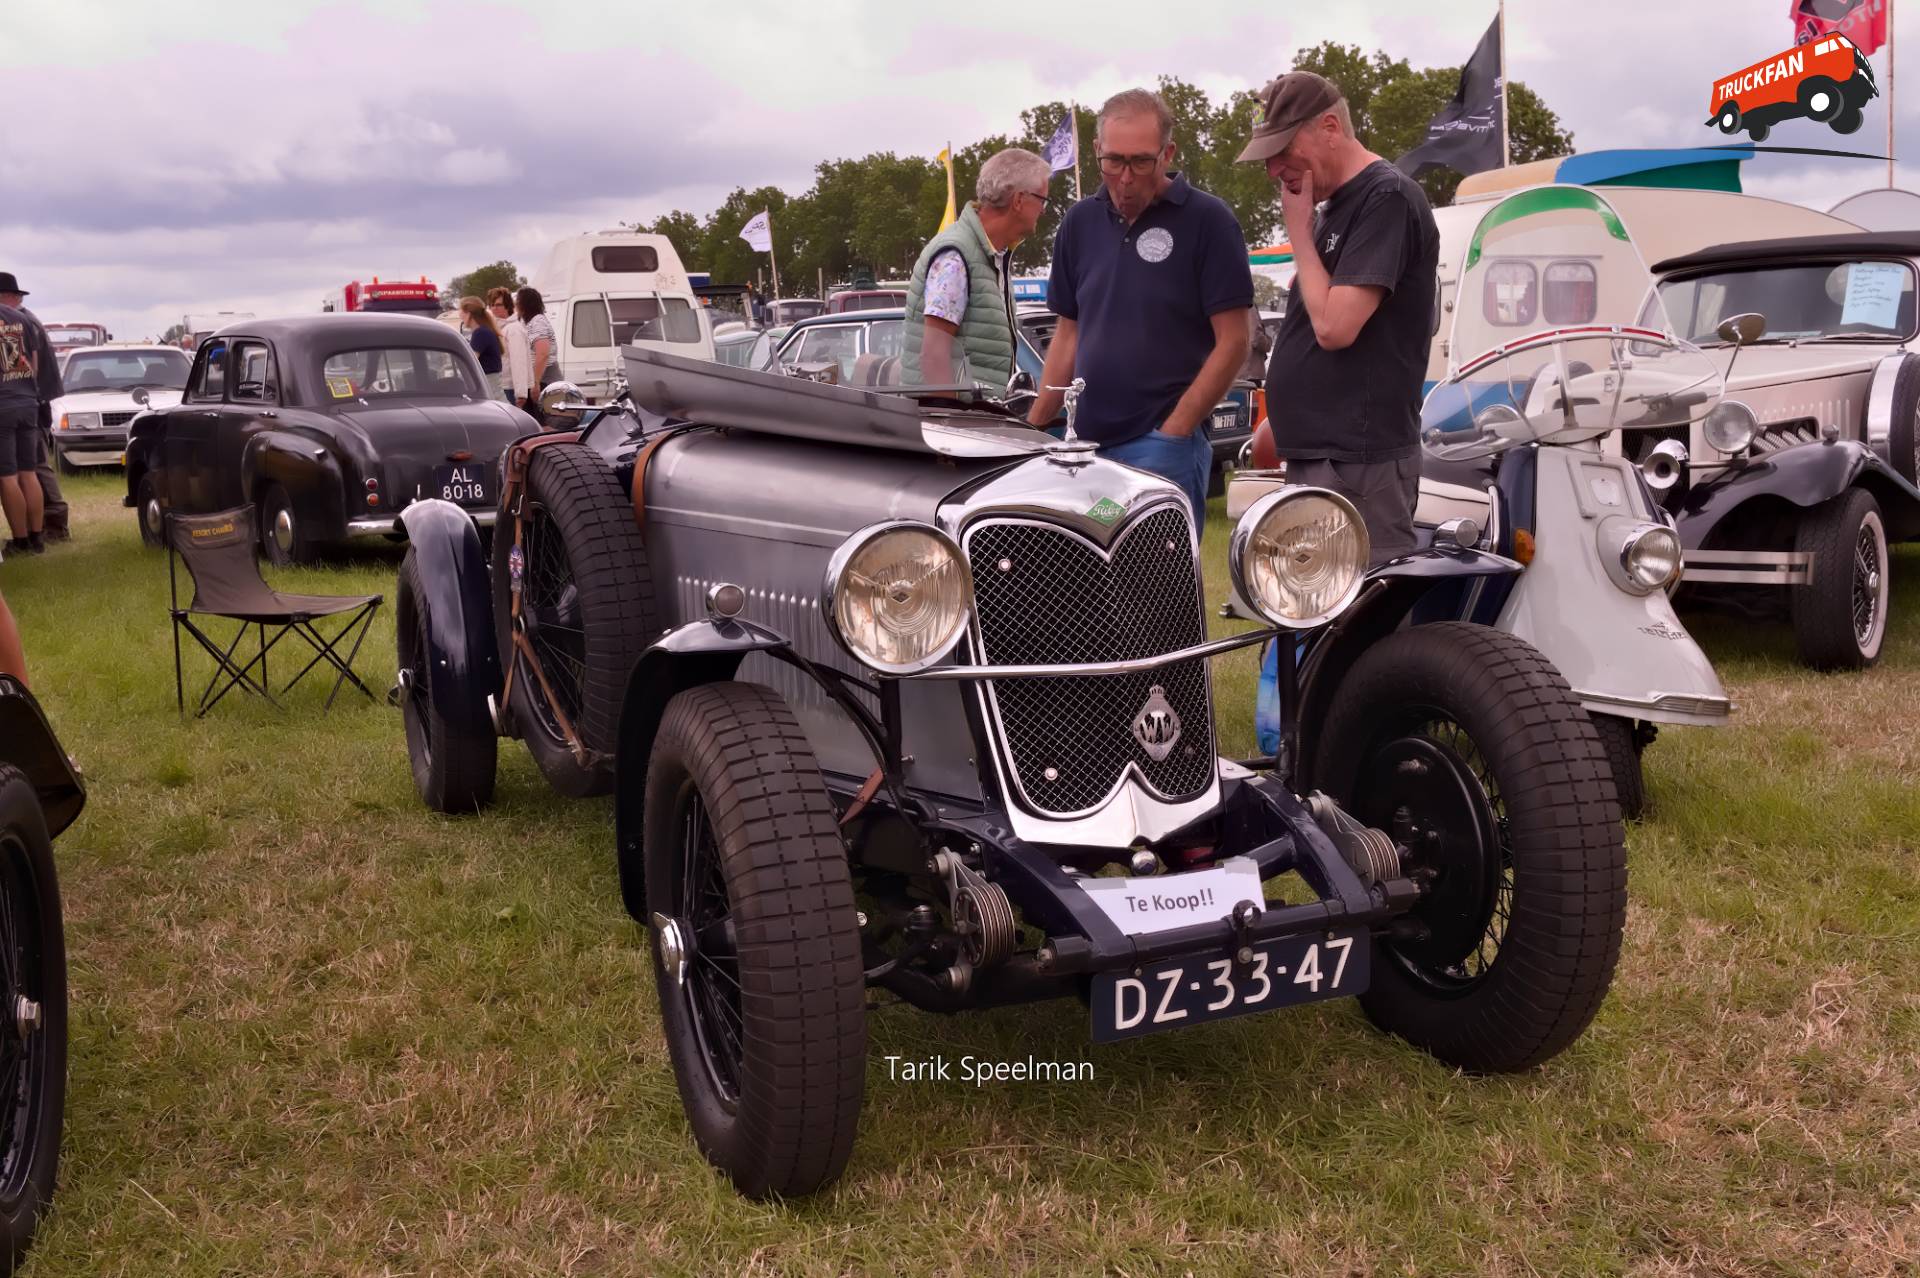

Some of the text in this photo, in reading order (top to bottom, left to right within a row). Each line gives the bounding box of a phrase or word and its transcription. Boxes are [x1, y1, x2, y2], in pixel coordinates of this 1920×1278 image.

[451, 468, 473, 483] AL
[443, 484, 483, 500] 80-18
[1093, 503, 1121, 519] Riley
[1125, 888, 1215, 913] Te Koop!!
[1115, 937, 1354, 1030] DZ-33-47
